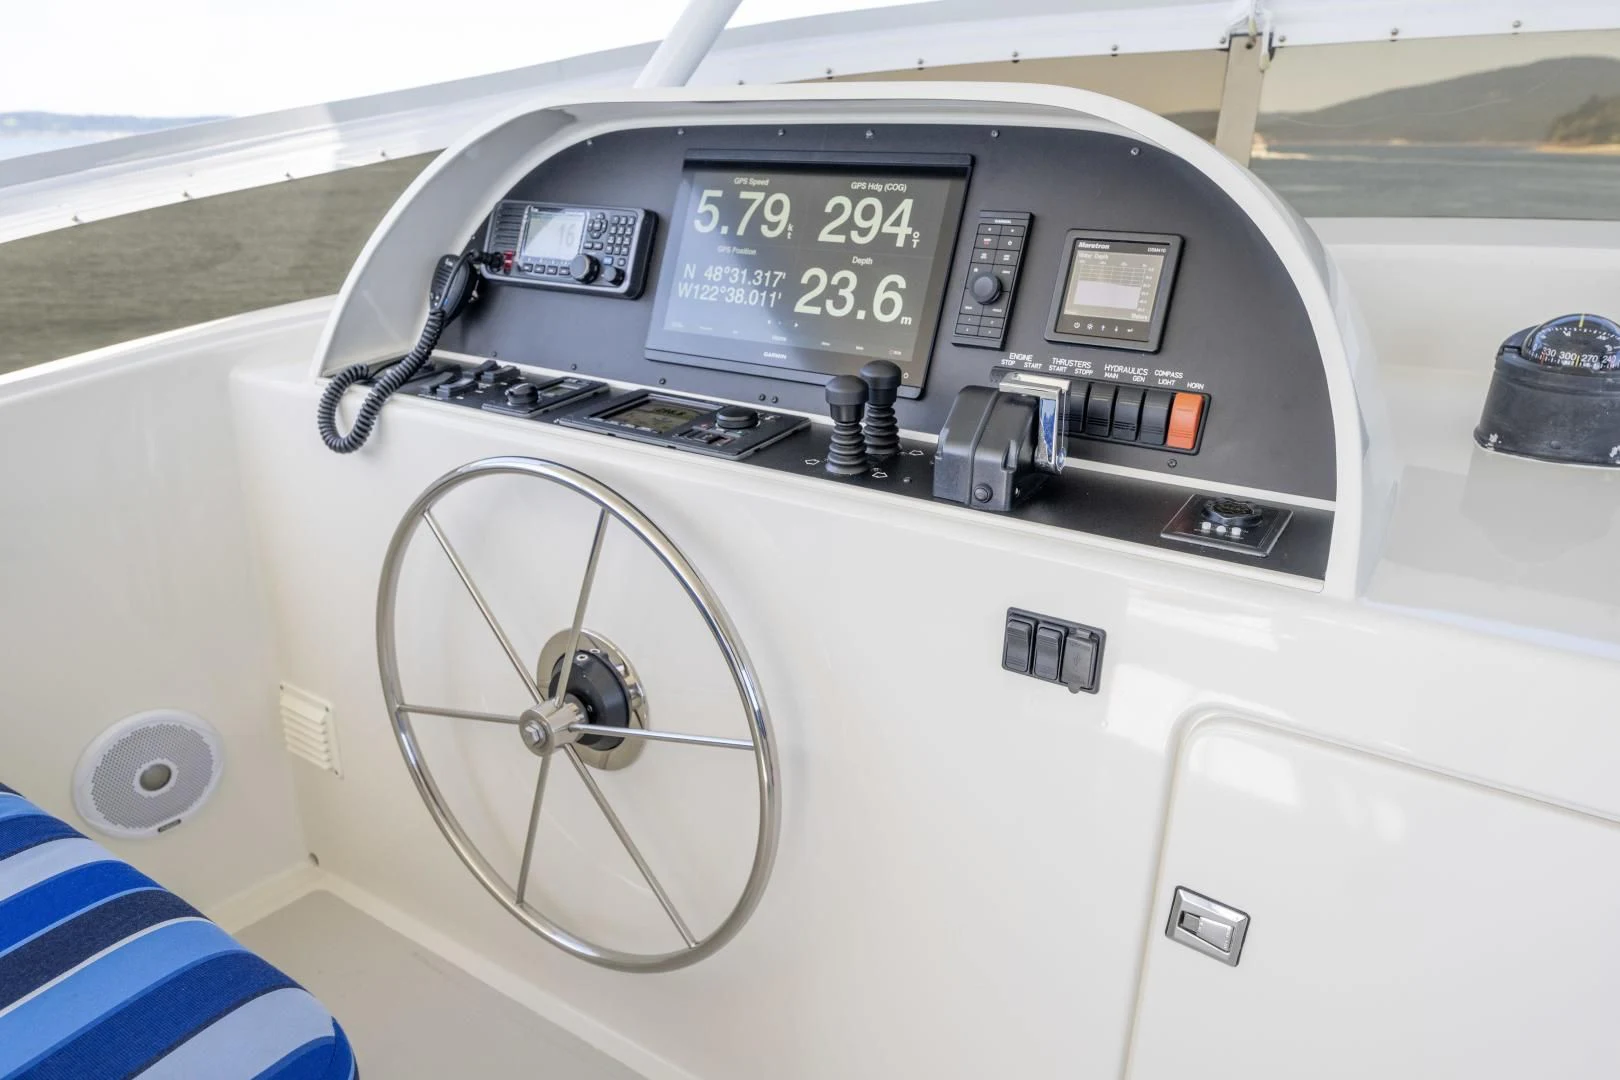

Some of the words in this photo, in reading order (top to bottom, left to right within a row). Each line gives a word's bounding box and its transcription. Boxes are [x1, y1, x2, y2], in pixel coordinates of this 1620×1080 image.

[734, 177, 748, 185] GPS
[749, 178, 770, 187] Speed
[851, 181, 867, 190] GPS
[868, 182, 883, 192] Hdg
[884, 183, 907, 193] (COG)
[694, 189, 791, 238] 5.79
[817, 195, 914, 248] 294
[852, 256, 873, 266] Depth
[683, 263, 697, 279] N
[794, 267, 907, 322] 23.6
[900, 316, 912, 326] m
[763, 351, 787, 360] GARMIN
[1009, 352, 1033, 361] ENGINE
[1559, 351, 1577, 361] 300
[1581, 354, 1598, 363] 270
[1048, 365, 1067, 373] START
[1052, 357, 1092, 369] THRUSTERS
[1104, 363, 1148, 376] HYDRAULICS
[1154, 369, 1183, 379] COMPASS
[1187, 382, 1204, 390] HORN
